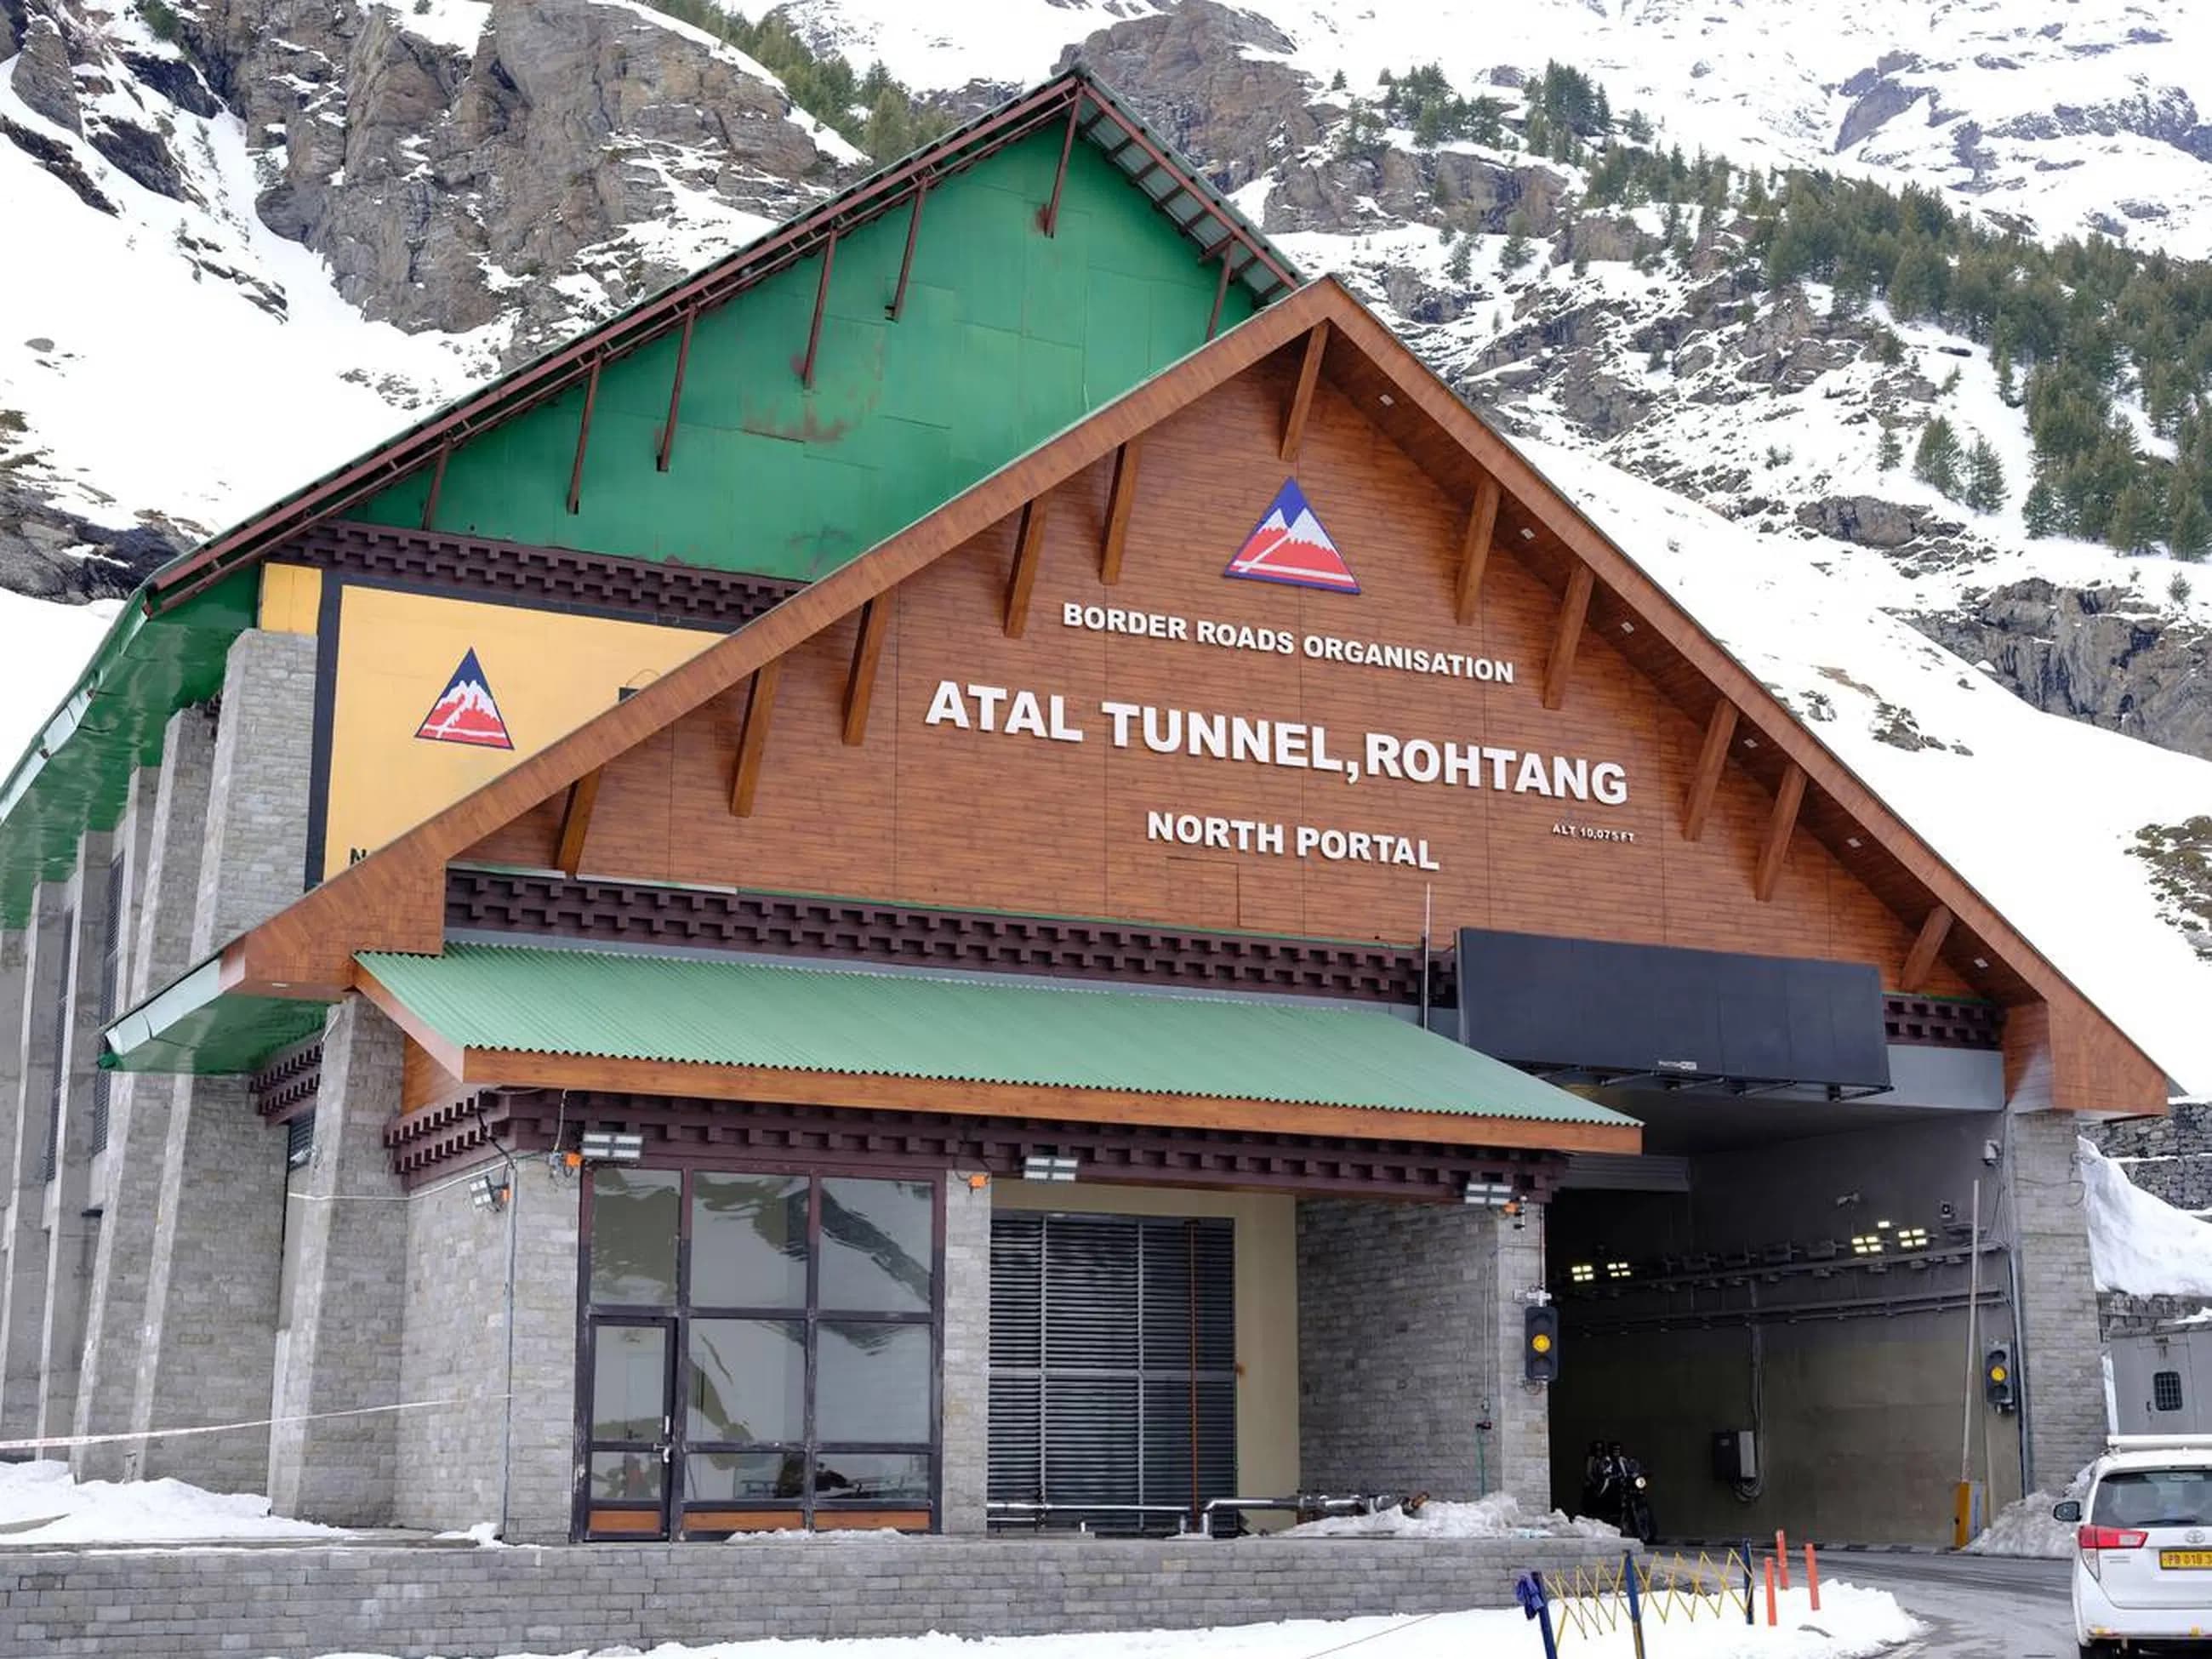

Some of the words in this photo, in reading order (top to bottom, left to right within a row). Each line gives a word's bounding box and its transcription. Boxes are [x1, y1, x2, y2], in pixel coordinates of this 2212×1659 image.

[1063, 601, 1189, 641] BORDER
[1196, 619, 1295, 655] ROADS
[1303, 635, 1514, 684] ORGANISATION
[924, 679, 1084, 743] ATAL
[1147, 810, 1285, 855] NORTH
[1297, 825, 1440, 871] PORTAL
[1553, 824, 1576, 835] ALT
[1620, 831, 1634, 842] FT
